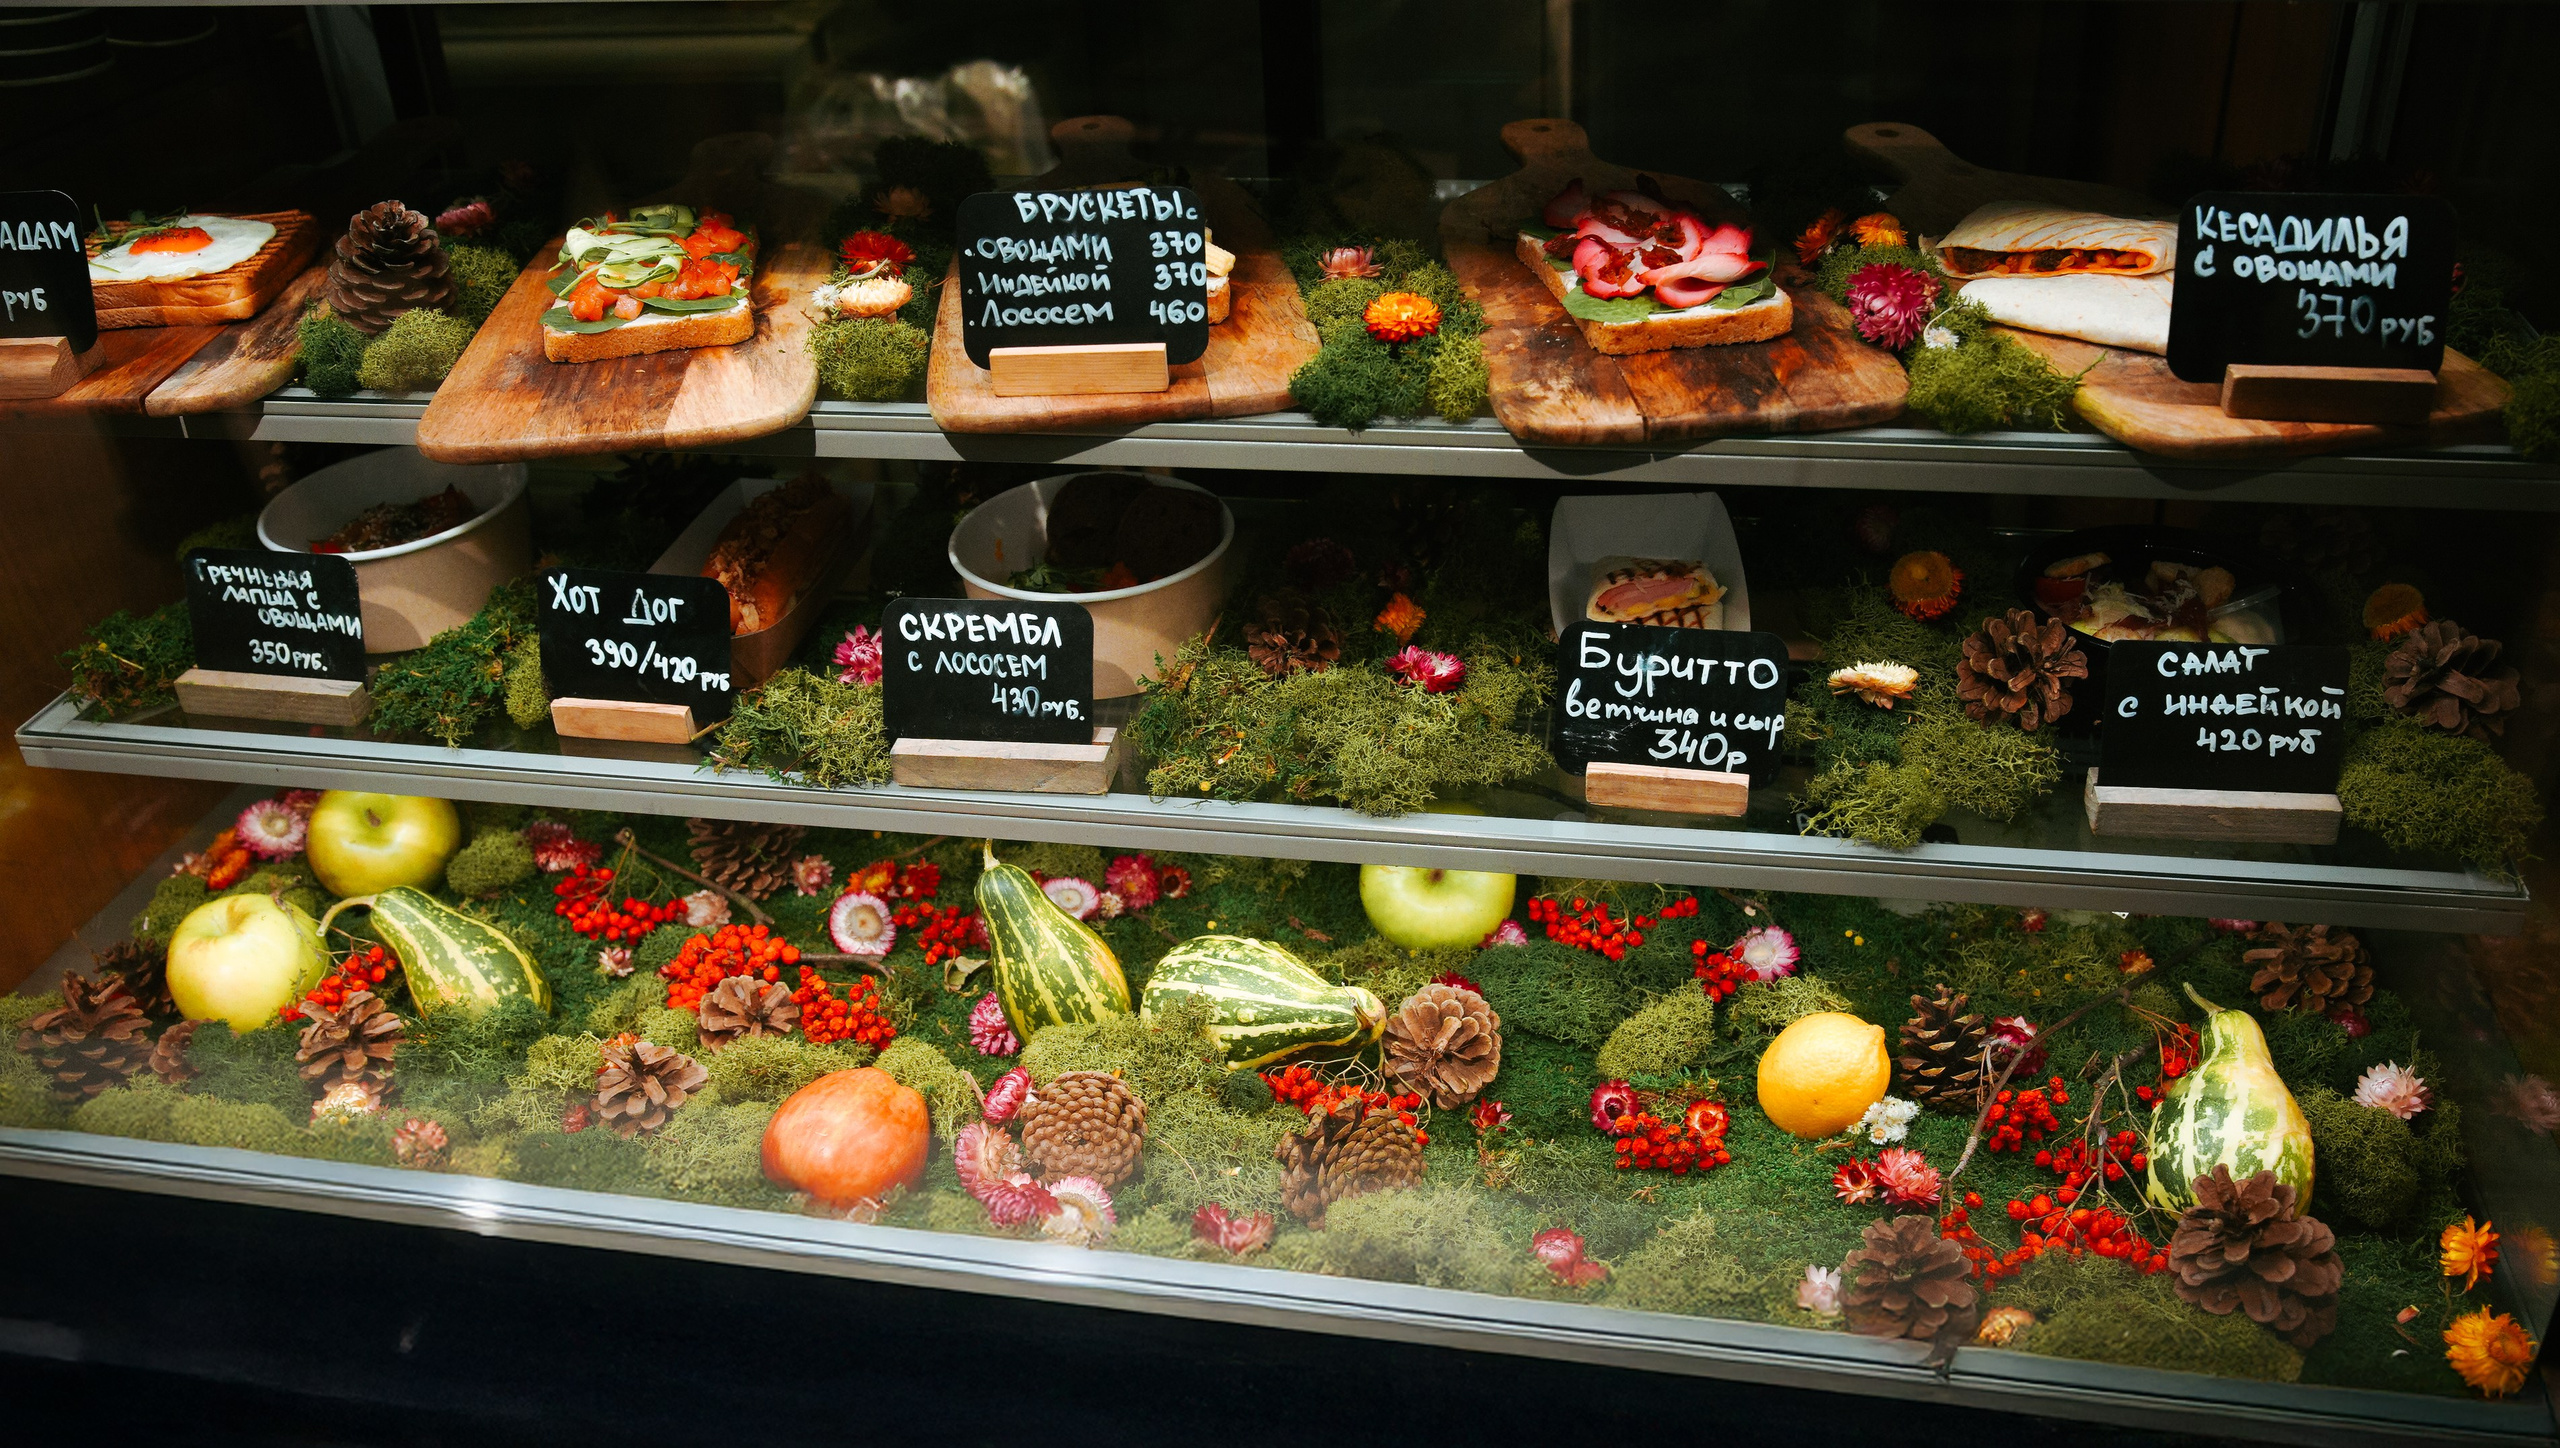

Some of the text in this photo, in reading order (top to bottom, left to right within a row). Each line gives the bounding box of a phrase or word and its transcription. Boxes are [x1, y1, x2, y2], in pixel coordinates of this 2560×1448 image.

[1012, 188, 1183, 224] БРУСКЕТЫ
[976, 231, 1203, 264] ОВОЩАМИ 370
[2195, 205, 2409, 261] КЕСАДИЛЬЯ
[1153, 262, 1206, 291] 370
[1150, 300, 1205, 325] 460
[2297, 288, 2376, 339] 370
[222, 585, 298, 609] ЛАПША
[258, 608, 362, 639] ОВОЩАМИ
[899, 612, 1062, 648] СКРЕМБЛ
[934, 651, 1046, 680] ЛОСОСЕМ
[1580, 631, 1779, 698] Буритто
[2157, 646, 2269, 678] САЛАТ
[2163, 686, 2345, 720] ИНДЕЙКОЙ
[1734, 714, 1784, 750] сыр
[2196, 727, 2263, 753] 420
